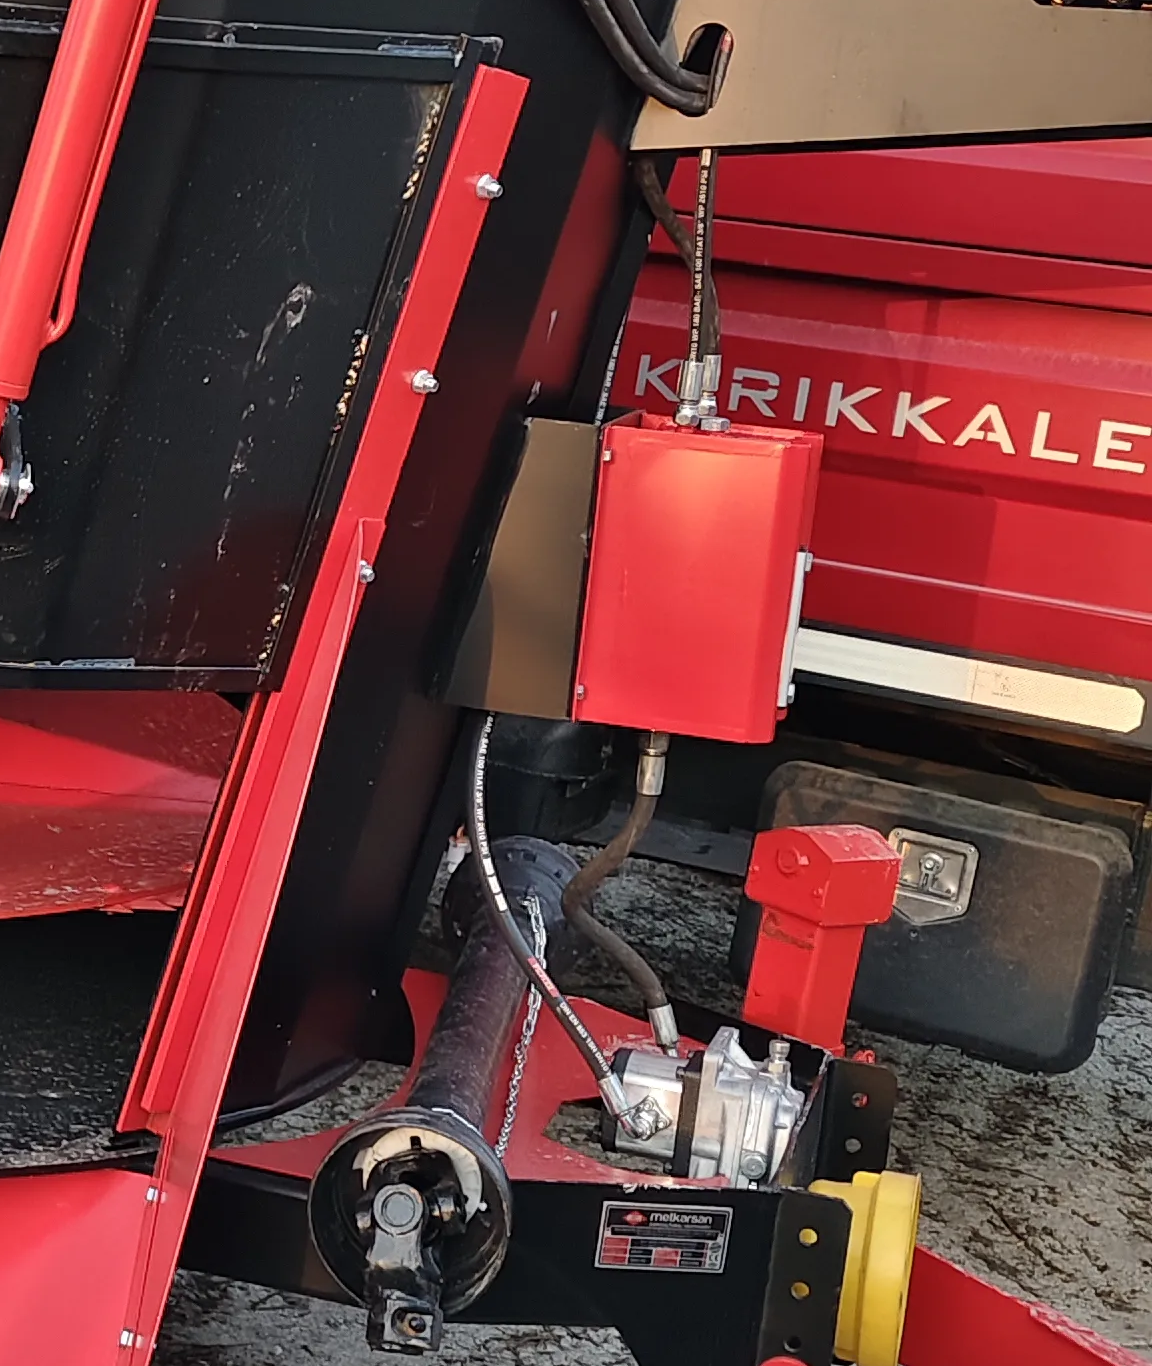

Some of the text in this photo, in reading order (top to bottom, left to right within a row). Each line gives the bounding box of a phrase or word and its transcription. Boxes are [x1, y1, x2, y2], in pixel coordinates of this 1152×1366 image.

[698, 204, 706, 218] WP
[694, 258, 703, 271] 100
[694, 273, 703, 290] SAE
[634, 354, 1151, 474] KRIKKALE
[479, 737, 489, 754] SAE
[477, 756, 486, 769] 100
[476, 808, 484, 822] WP
[559, 1001, 572, 1016] DIN
[568, 1015, 580, 1028] EN
